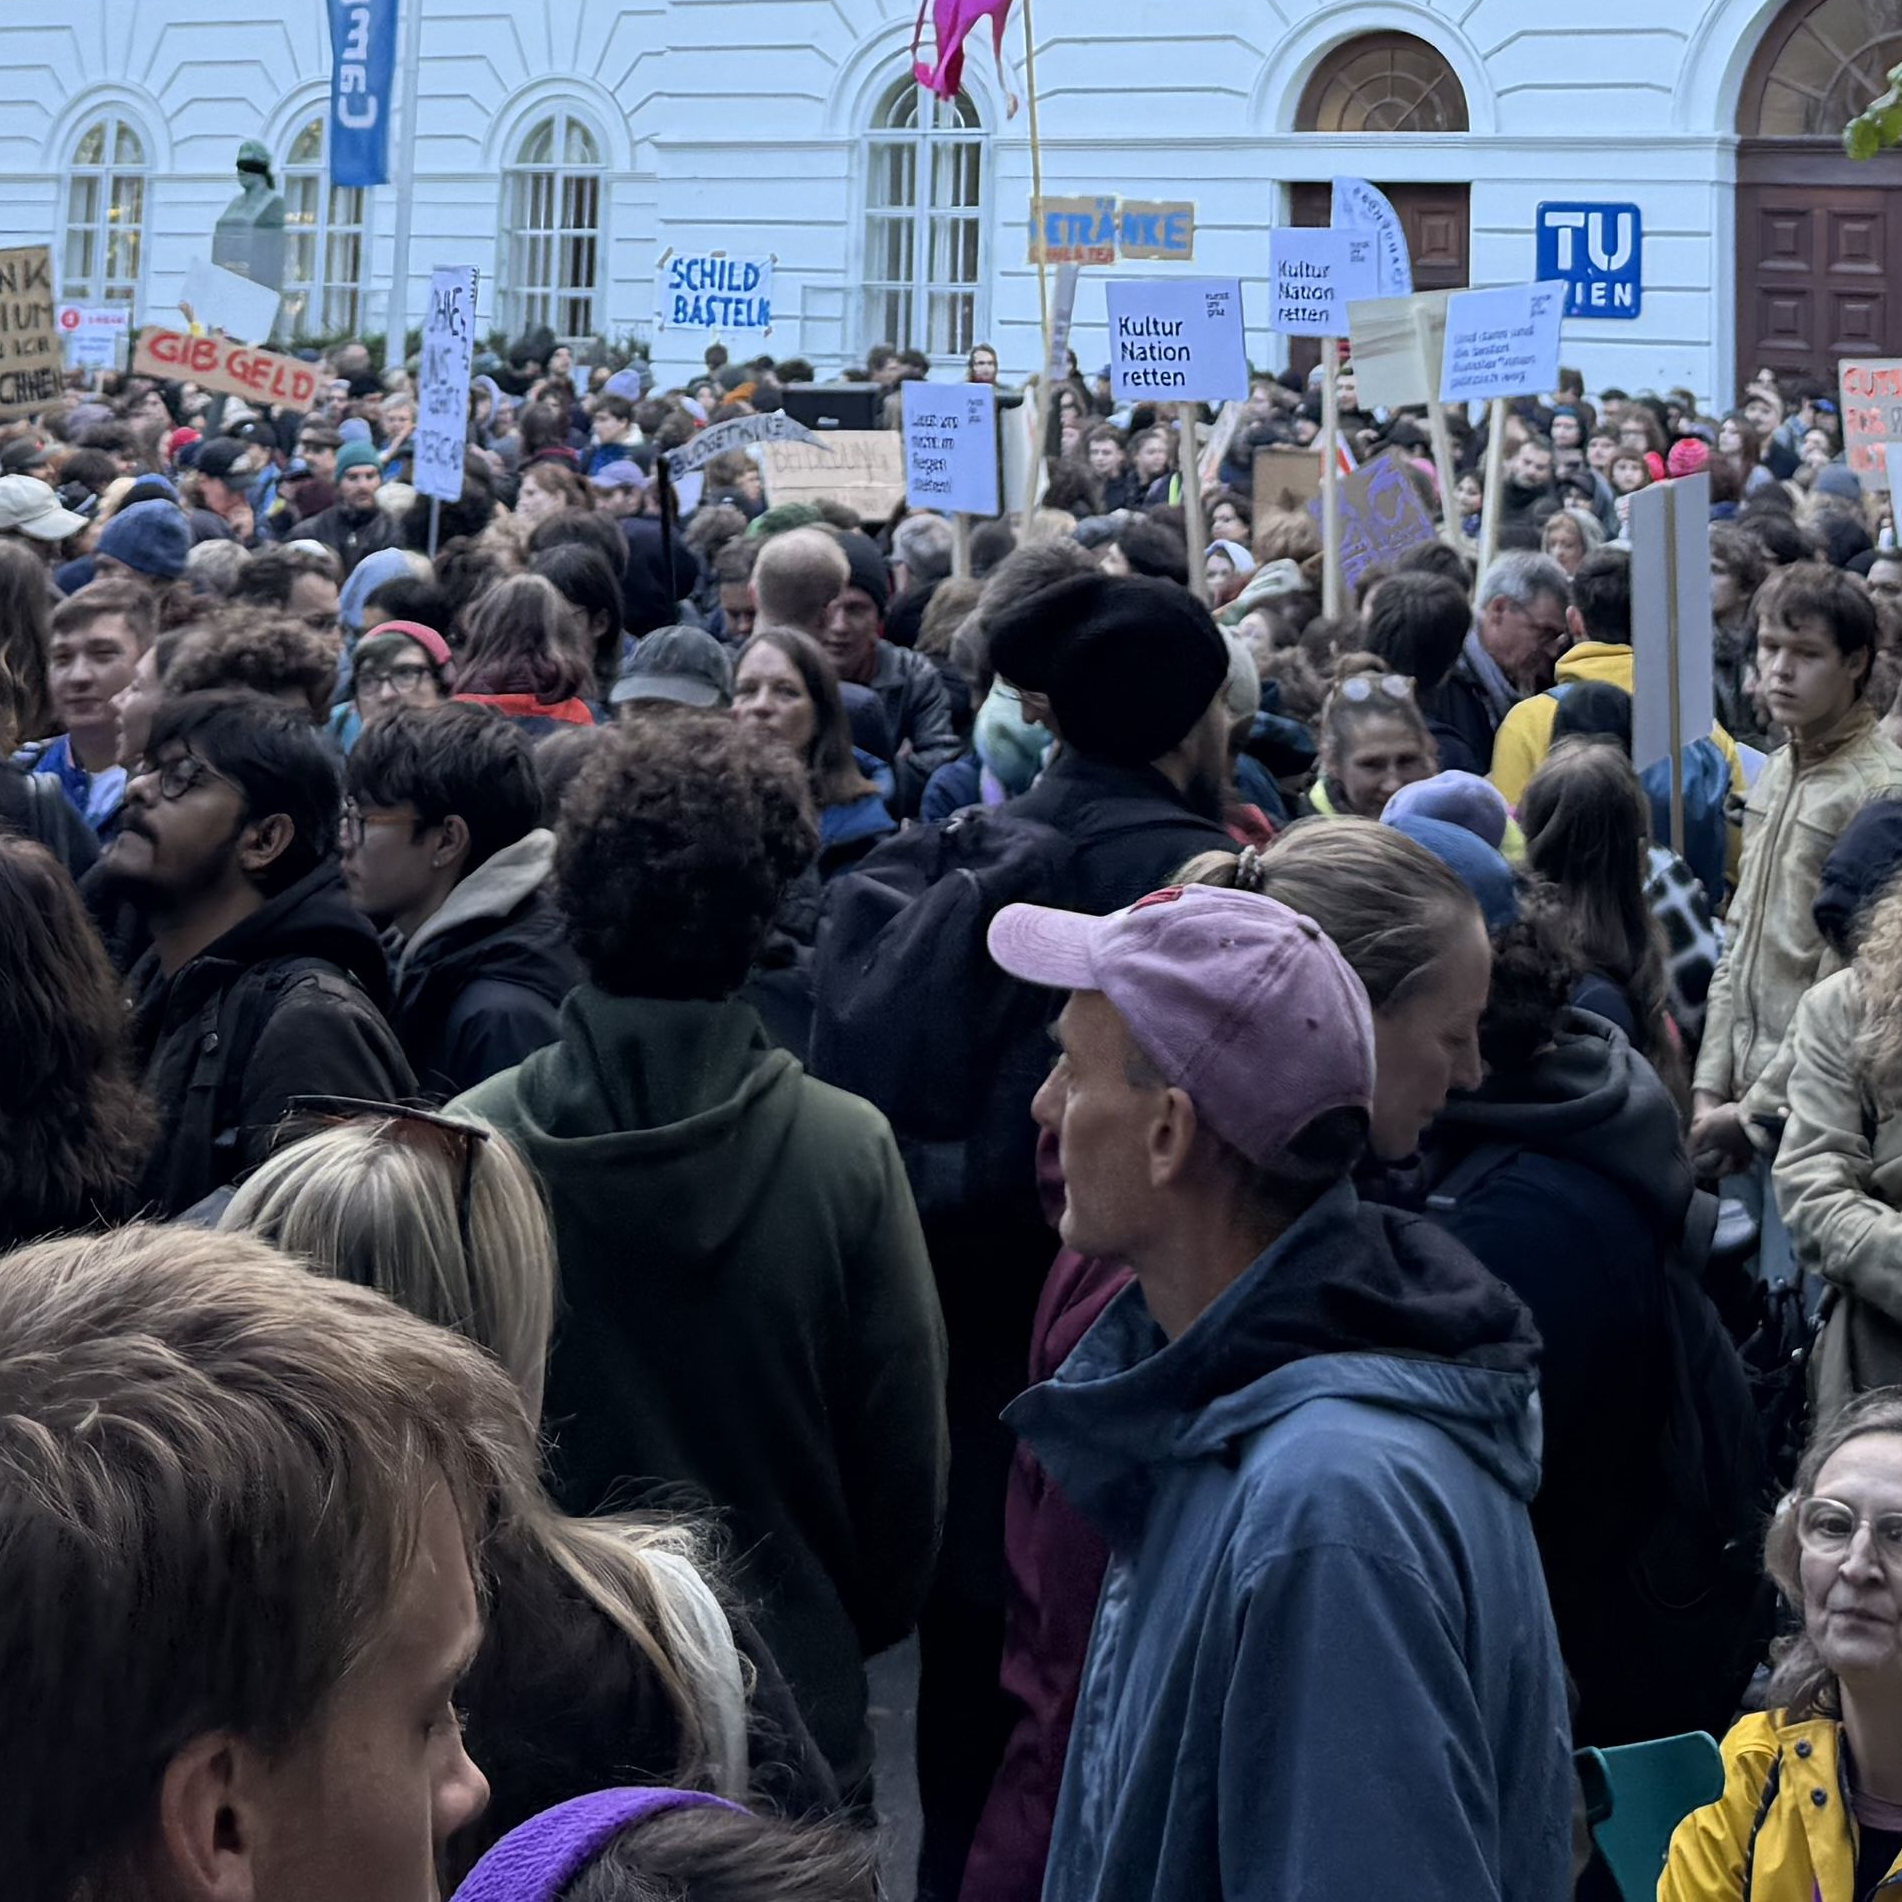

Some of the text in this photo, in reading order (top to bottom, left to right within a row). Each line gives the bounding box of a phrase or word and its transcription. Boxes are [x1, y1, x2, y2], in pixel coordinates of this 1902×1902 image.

[1544, 211, 1632, 272] TU
[668, 257, 761, 292] SCHILD
[1278, 260, 1330, 279] Kultur
[1561, 281, 1632, 307] IEN
[673, 295, 771, 328] BASTELN
[1118, 316, 1183, 337] Kultur
[1120, 341, 1191, 362] Nation
[149, 332, 218, 372] GIB
[226, 350, 315, 401] GELD
[1122, 368, 1186, 387] retten
